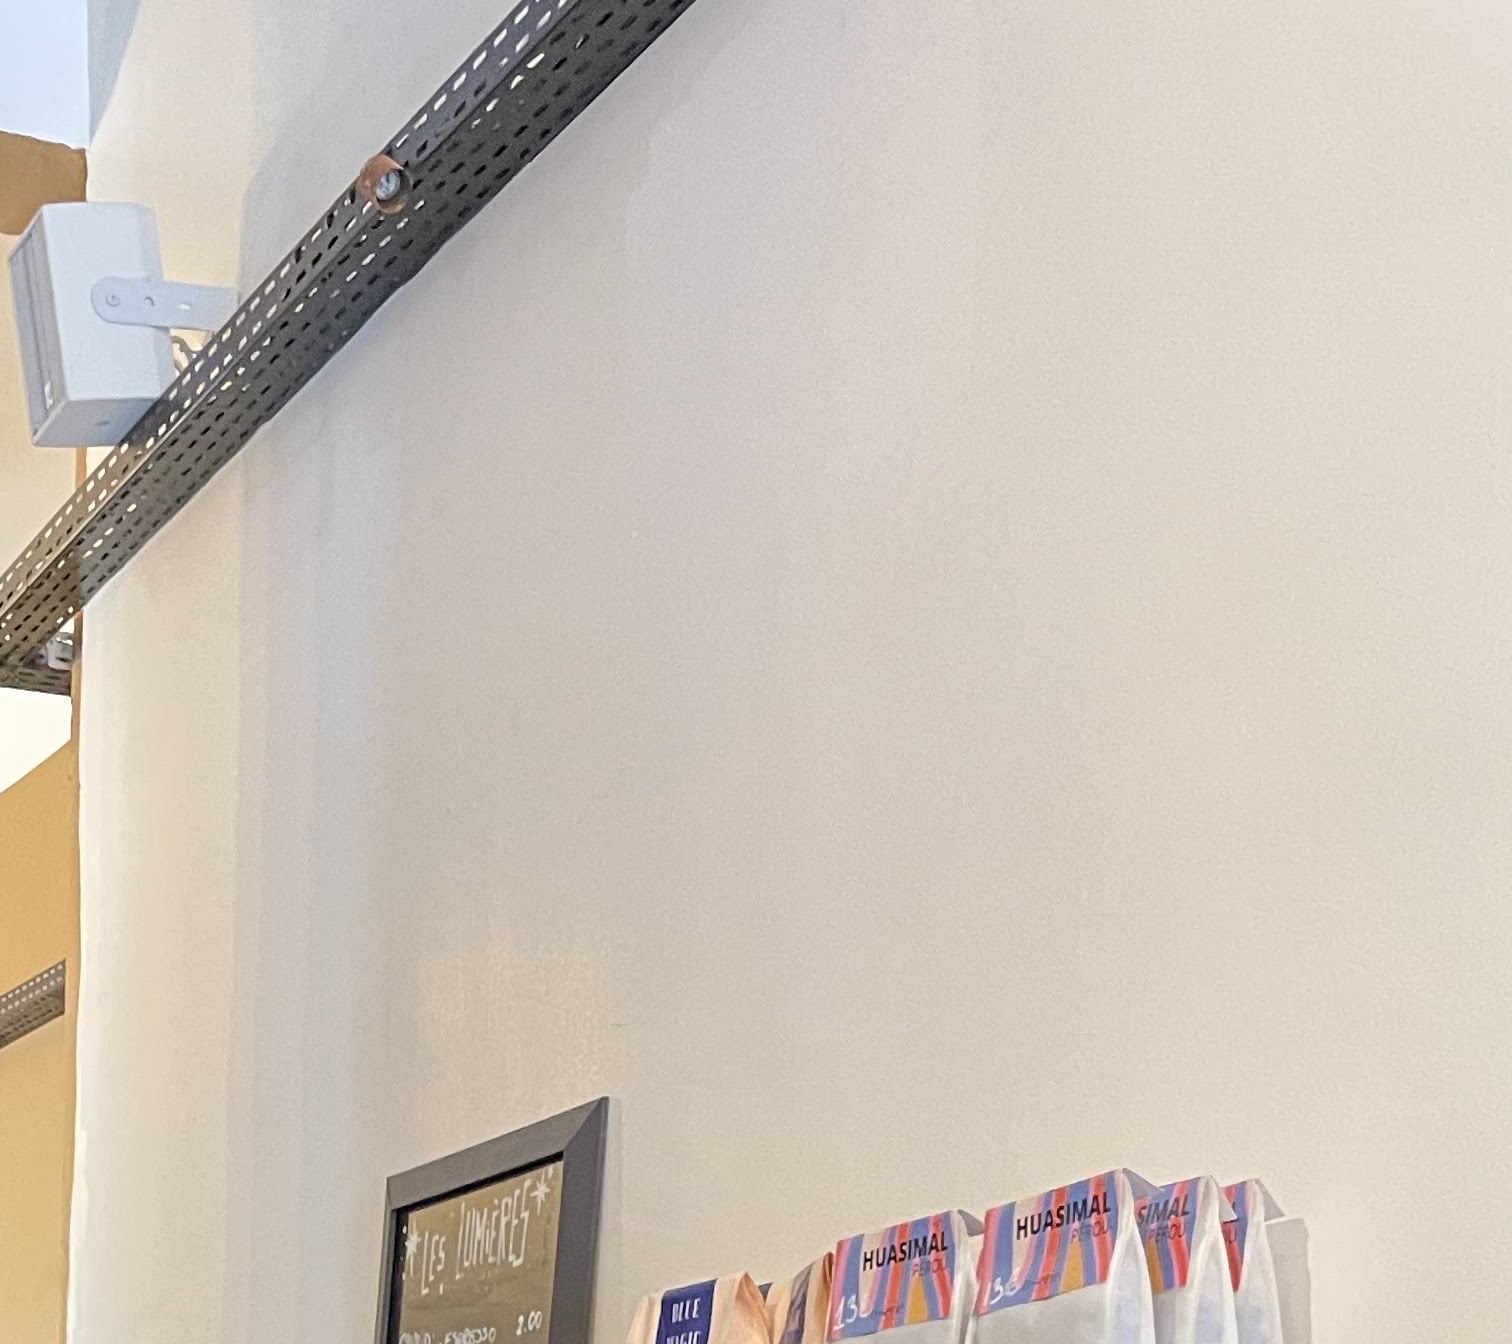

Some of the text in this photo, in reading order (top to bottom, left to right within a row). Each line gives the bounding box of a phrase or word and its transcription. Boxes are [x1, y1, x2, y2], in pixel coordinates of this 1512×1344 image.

[1015, 1192, 1112, 1241] HUASIMAL
[1138, 1194, 1190, 1225] SIMAL
[421, 1231, 446, 1296] LES
[862, 1230, 949, 1271] HUASIMAL
